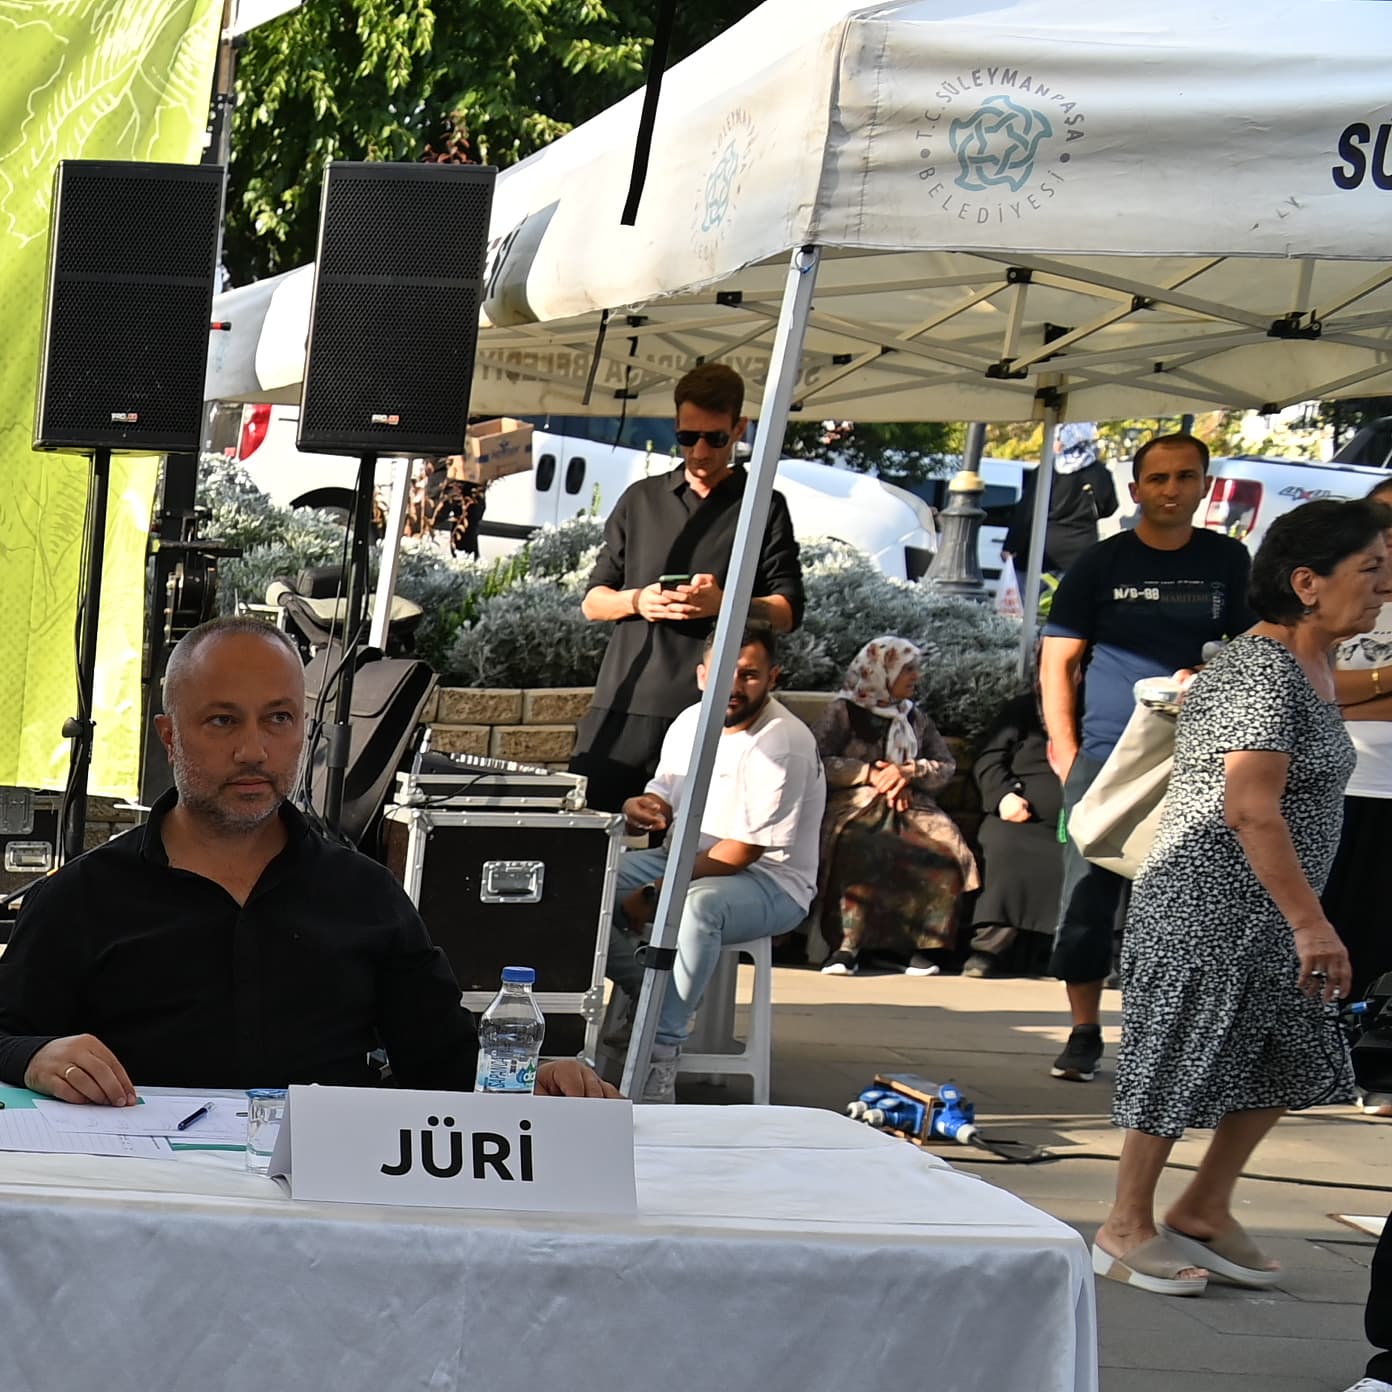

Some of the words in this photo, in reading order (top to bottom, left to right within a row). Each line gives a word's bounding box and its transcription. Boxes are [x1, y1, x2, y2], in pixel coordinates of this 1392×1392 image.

[935, 66, 1086, 143] SÜLEYMANPAŞA
[918, 165, 1065, 225] BELEDİYESİ
[380, 1115, 534, 1182] JÜRİ
